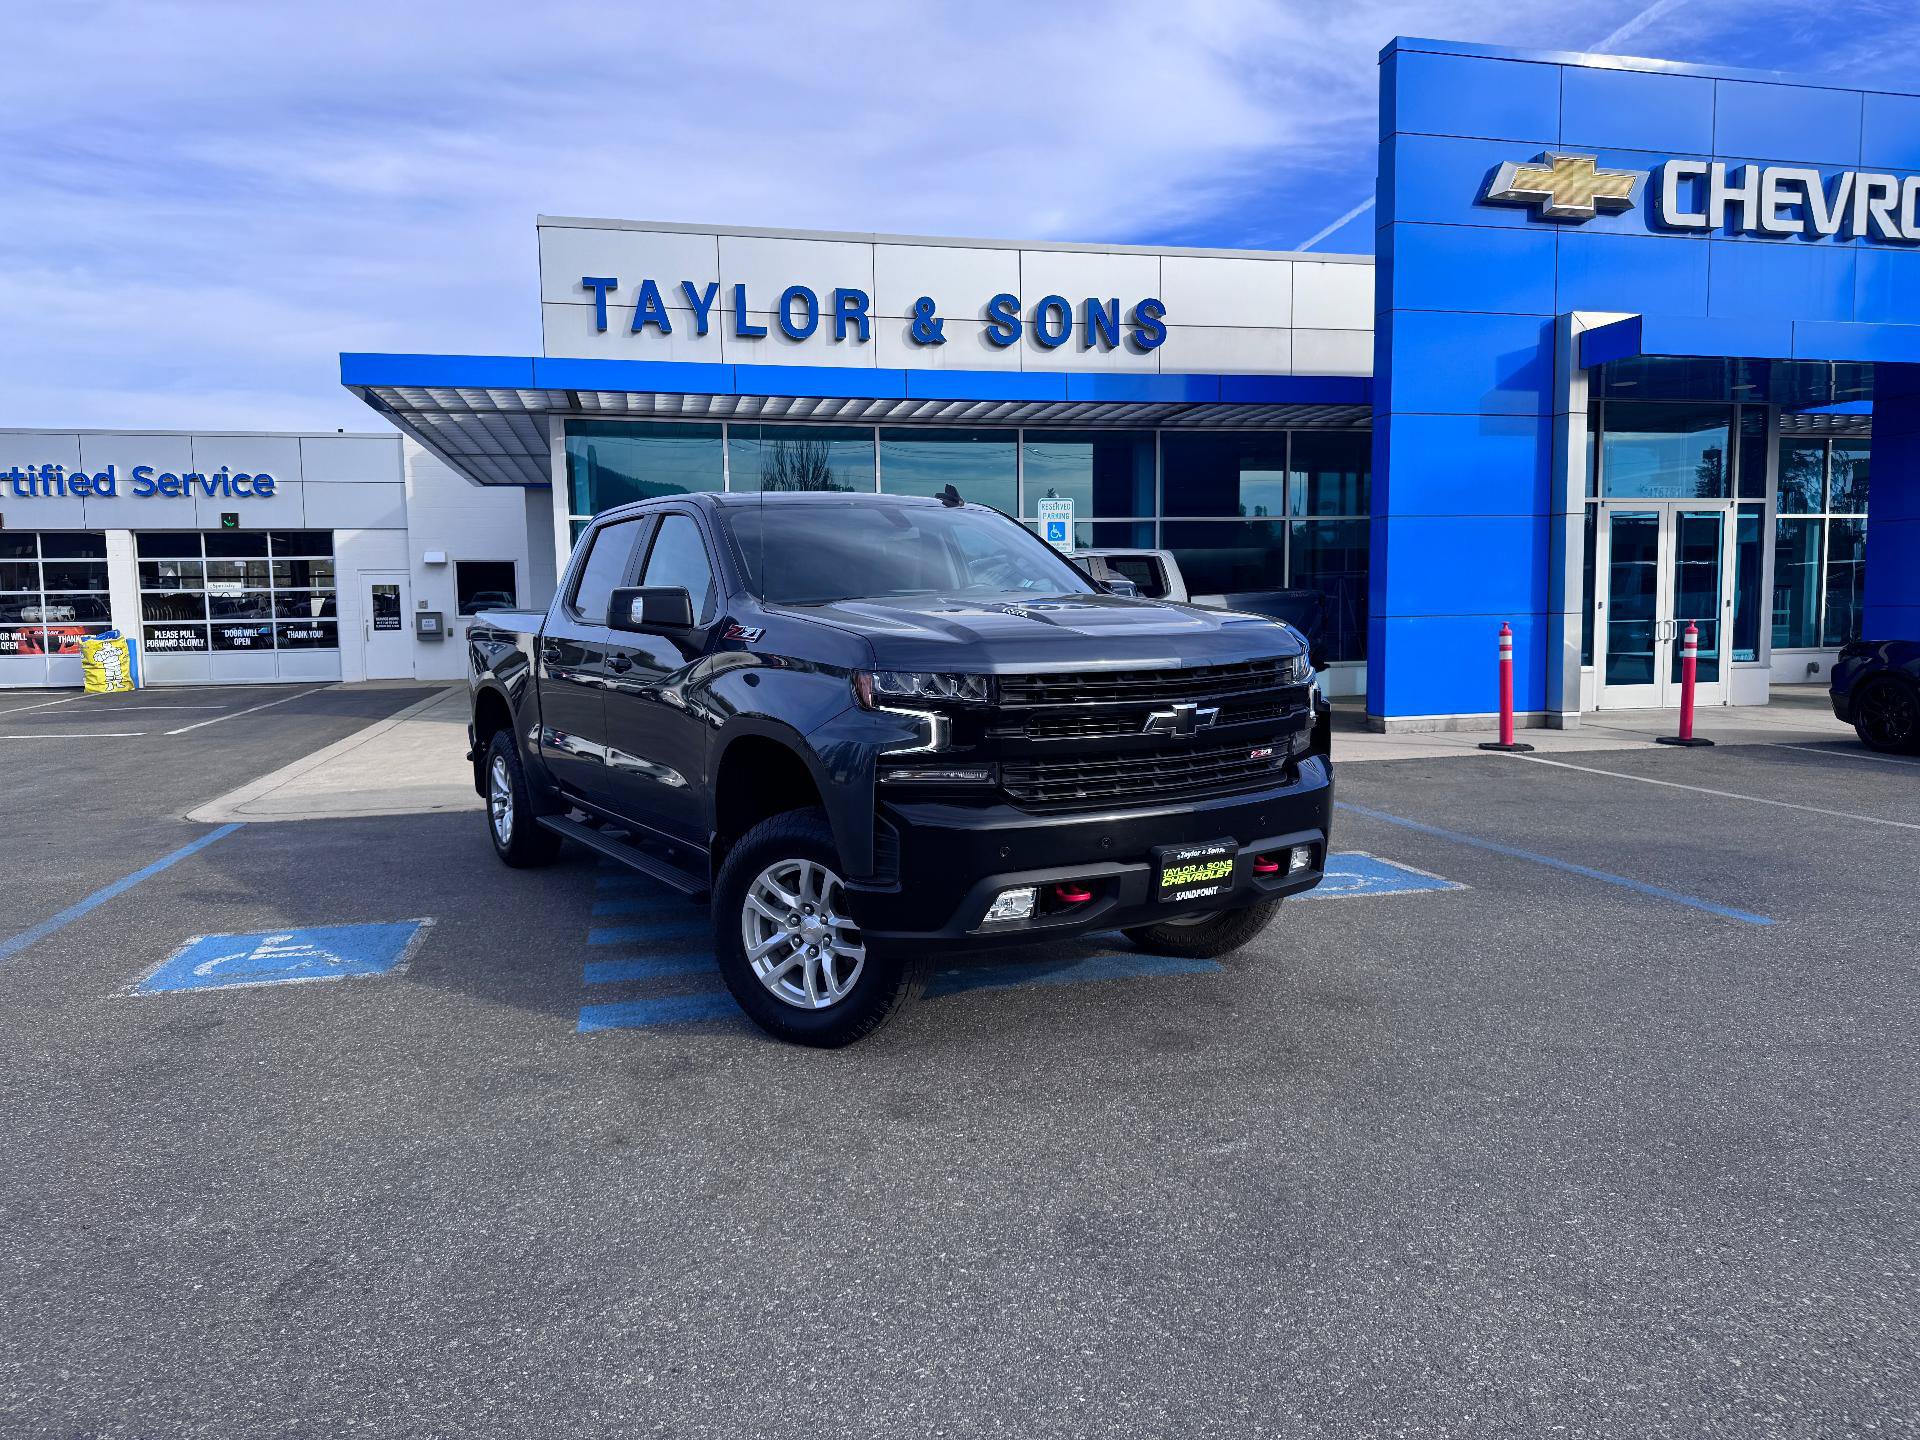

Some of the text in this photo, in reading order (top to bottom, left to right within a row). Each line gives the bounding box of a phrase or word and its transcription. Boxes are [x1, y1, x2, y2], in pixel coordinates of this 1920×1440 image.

[582, 276, 1167, 350] TAYLOR & SONS
[132, 465, 275, 497] Service
[1041, 503, 1071, 511] RESERVED
[1042, 512, 1070, 520] PARKING
[0, 632, 10, 641] OR
[10, 632, 28, 641] WILL
[154, 629, 197, 639] PLEASE PULL
[224, 628, 259, 638] DOOR WILL
[286, 630, 324, 639] THANK YOU!
[0, 641, 19, 650] OPEN
[146, 638, 205, 648] FORWARD SLOWLY
[233, 637, 252, 646] OPEN
[1181, 850, 1201, 859] Taylor
[1163, 865, 1196, 877] TAYLOR
[1207, 860, 1232, 869] SONS
[1162, 868, 1232, 886] CHEVROLET
[1176, 886, 1218, 901] SANDPOINT
